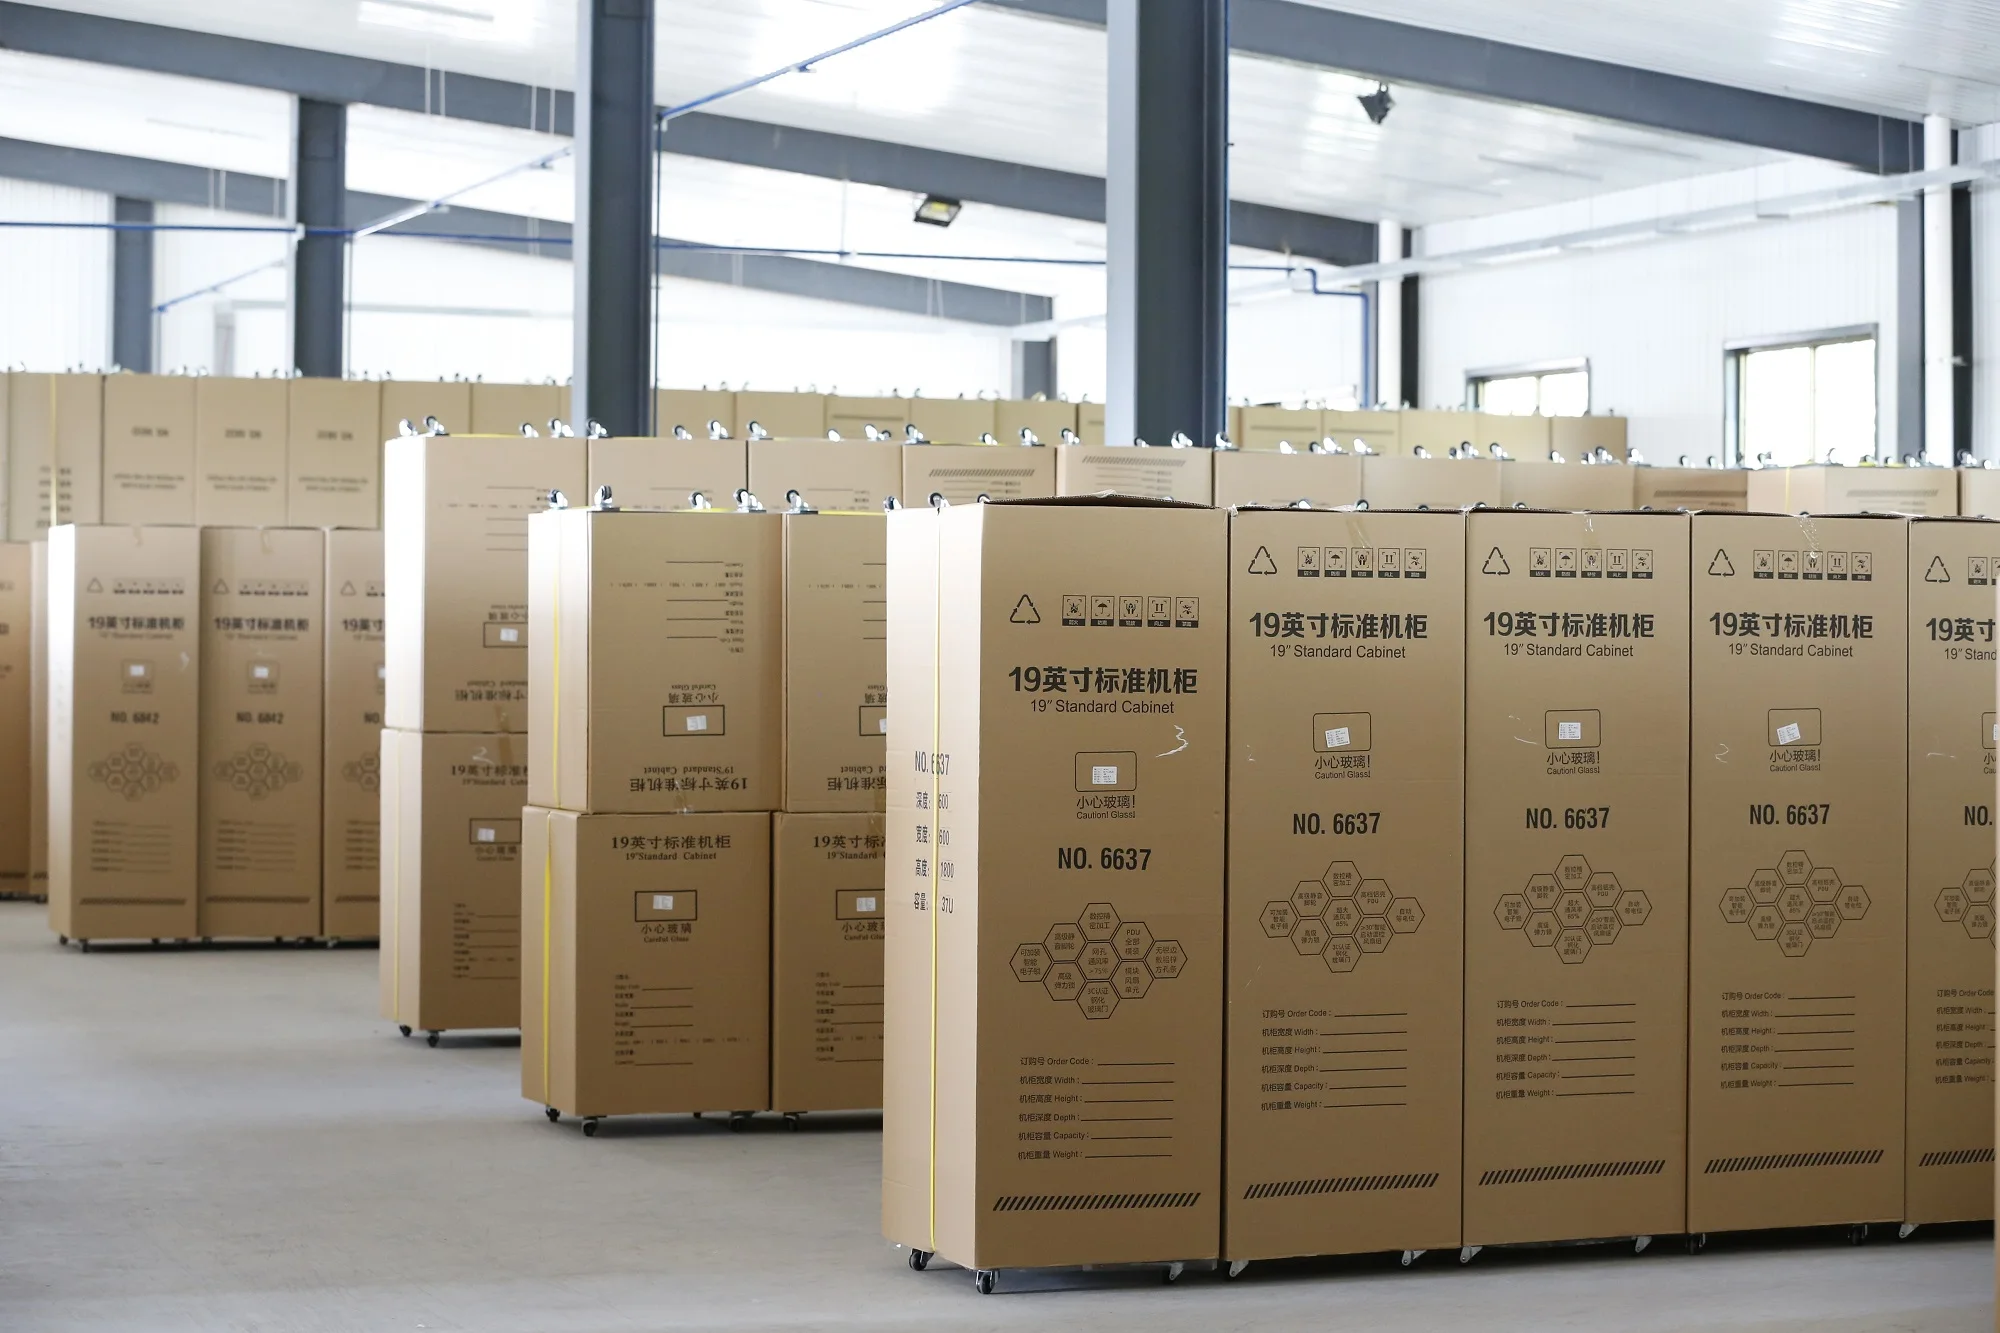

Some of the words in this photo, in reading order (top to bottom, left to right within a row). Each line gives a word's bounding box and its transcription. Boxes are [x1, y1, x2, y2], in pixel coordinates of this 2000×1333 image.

[1249, 612, 1428, 639] 19英寸标准机柜
[1483, 612, 1654, 638] 19英寸标准机柜
[1709, 612, 1873, 639] 19英寸标准机柜
[1294, 645, 1351, 658] Standard
[1356, 645, 1406, 658] Cabinet
[1527, 643, 1582, 656] Standard
[1586, 644, 1633, 657] Cabinet
[1750, 643, 1803, 657] Standard
[1808, 644, 1853, 658] Cabinet
[1008, 666, 1197, 694] 19英寸标准机柜
[668, 693, 719, 703] 小心玻璃
[1056, 700, 1117, 713] Standard
[1122, 700, 1174, 713] Cabinet
[915, 751, 928, 773] NO.
[630, 778, 748, 792] 19英寸标准机柜
[1293, 813, 1325, 834] NO.
[1333, 812, 1381, 835] 6637
[1526, 808, 1557, 829] NO.
[1565, 807, 1610, 829] 6637
[1750, 804, 1779, 825] NO.
[1787, 804, 1830, 825] 6637
[1964, 806, 1993, 826] NO.
[612, 835, 731, 849] 19英寸标准机柜
[684, 852, 716, 860] Cabinet
[1058, 847, 1092, 869] NO.
[1101, 847, 1151, 870] 6637
[641, 923, 692, 934] 小心玻璃
